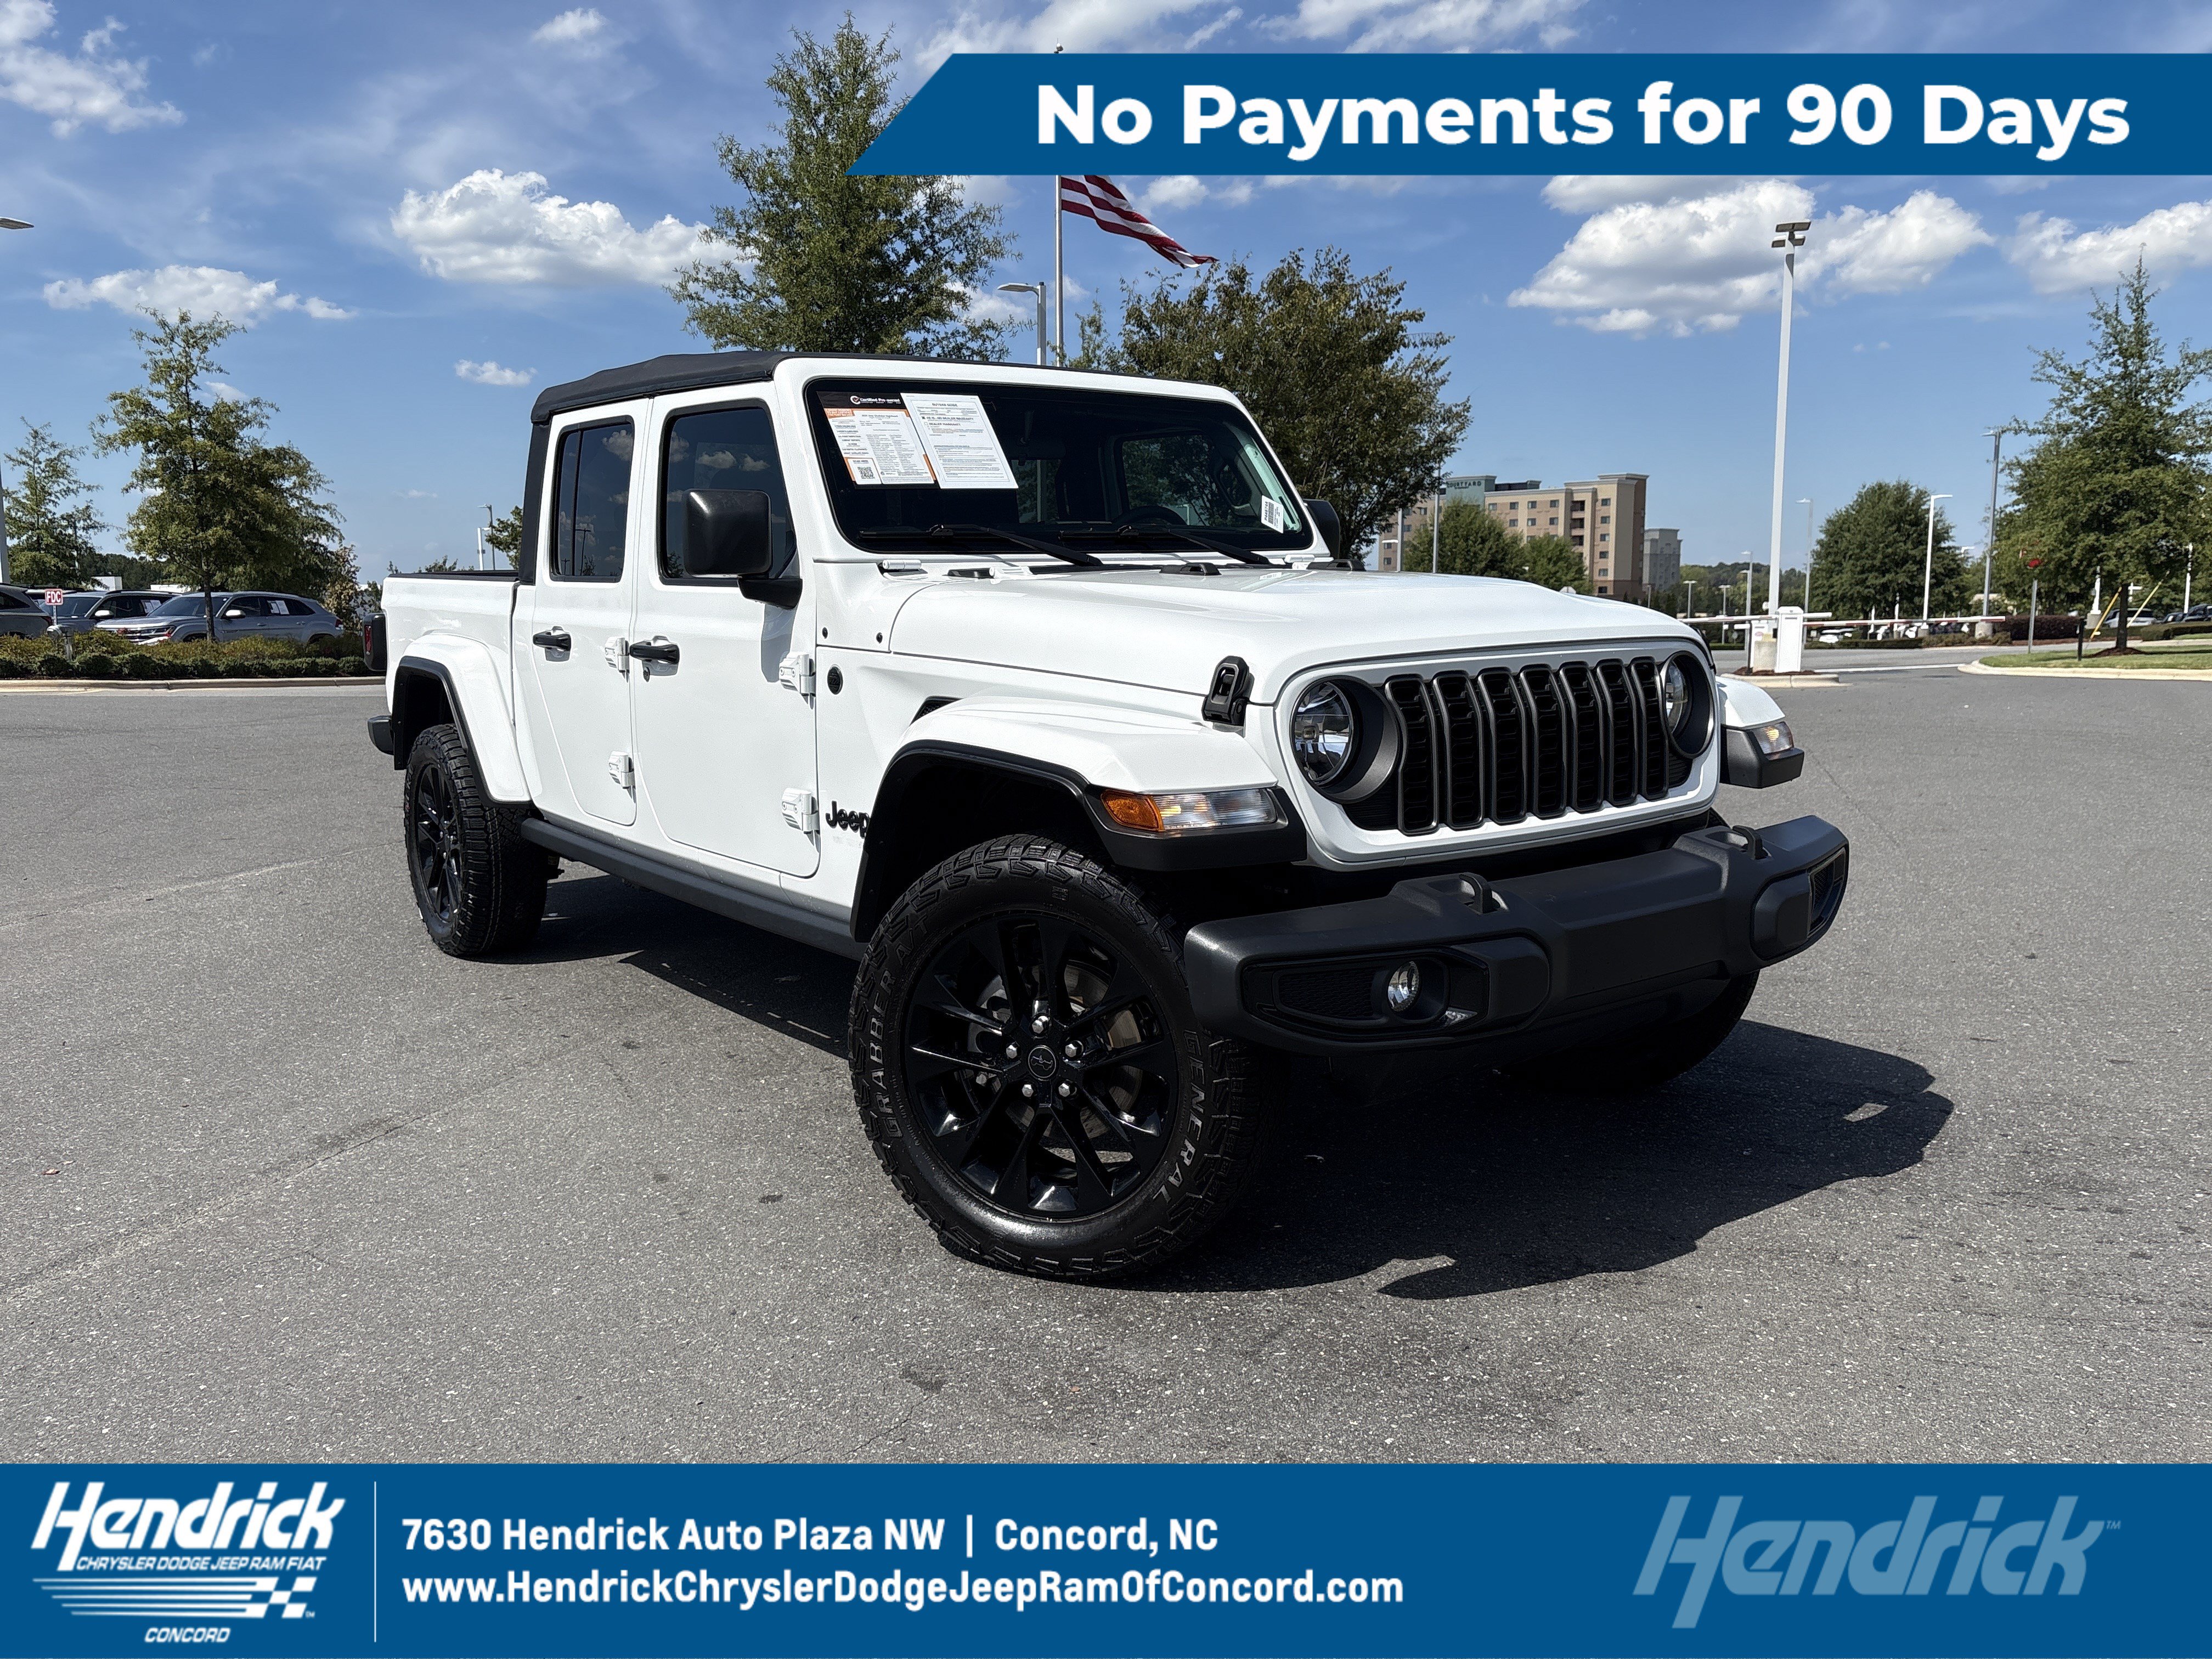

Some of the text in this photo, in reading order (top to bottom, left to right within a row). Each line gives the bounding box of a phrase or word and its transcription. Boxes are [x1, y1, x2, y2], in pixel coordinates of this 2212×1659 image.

[47, 591, 60, 602] FDC
[825, 800, 870, 839] Jeep
[870, 967, 903, 1138] GRABBER
[1152, 1029, 1205, 1204] GENERAL
